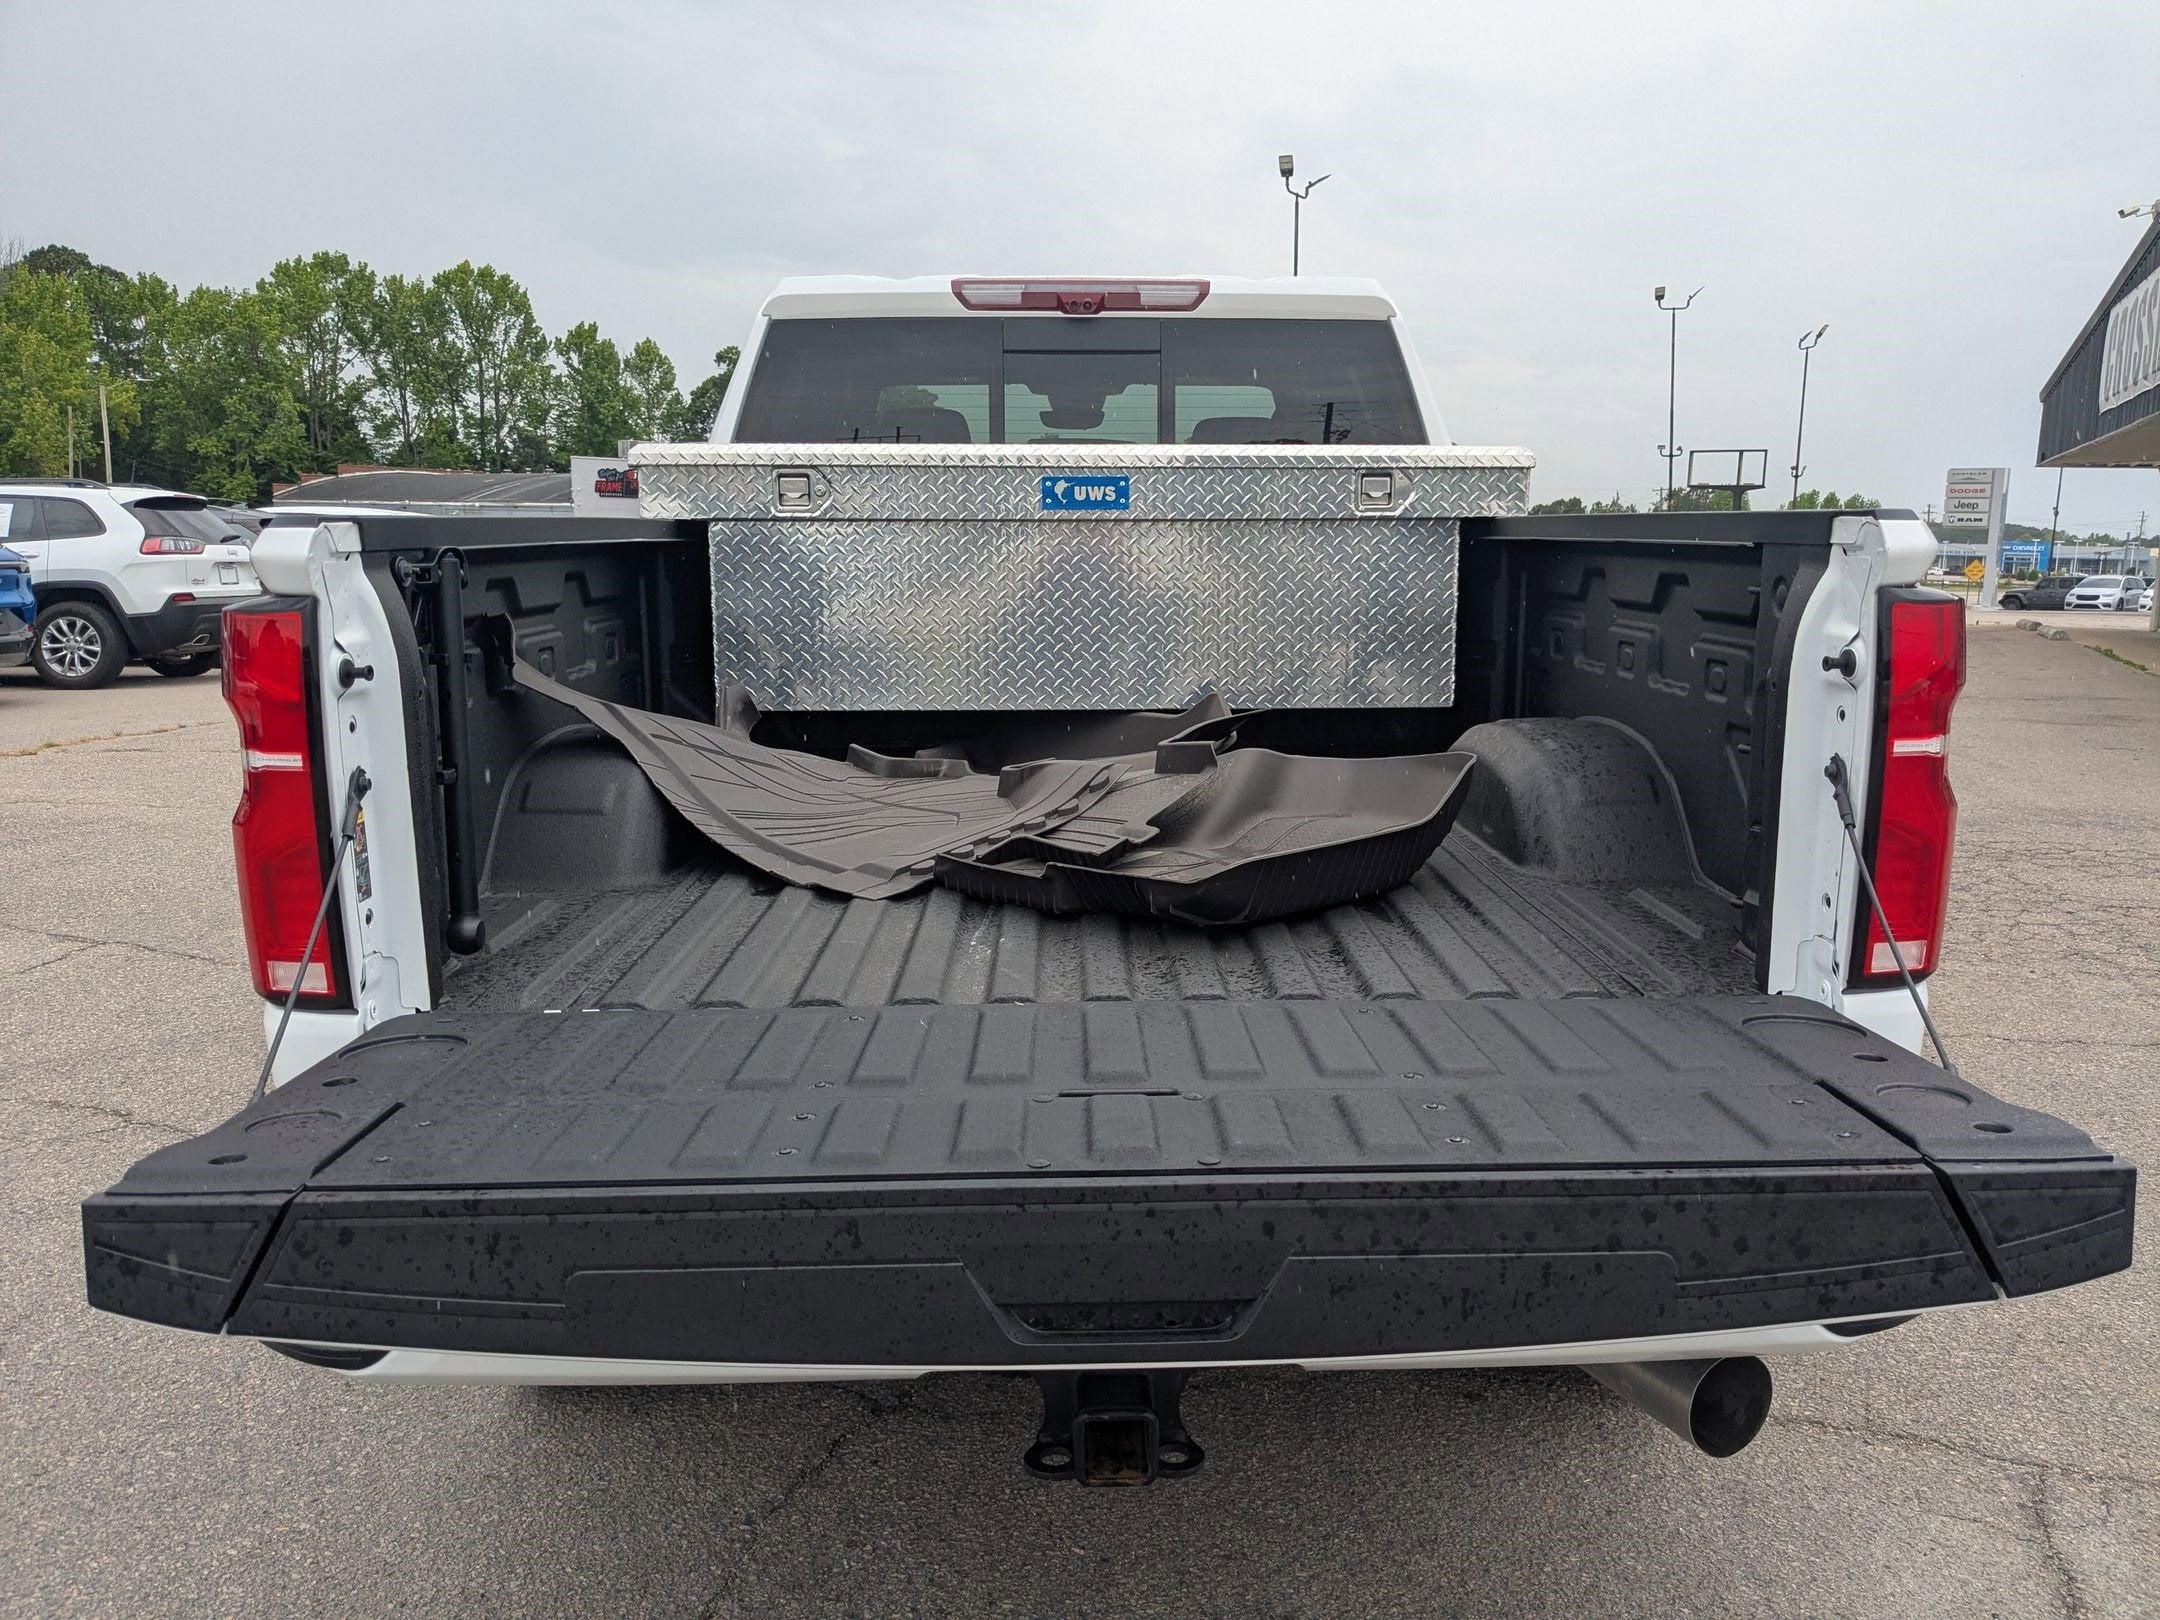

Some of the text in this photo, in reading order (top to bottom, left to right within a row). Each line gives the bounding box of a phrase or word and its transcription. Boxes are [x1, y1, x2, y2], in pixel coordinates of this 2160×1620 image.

[597, 481, 623, 491] FRAME
[1074, 486, 1116, 501] UWS
[1953, 500, 1979, 510] Jeep
